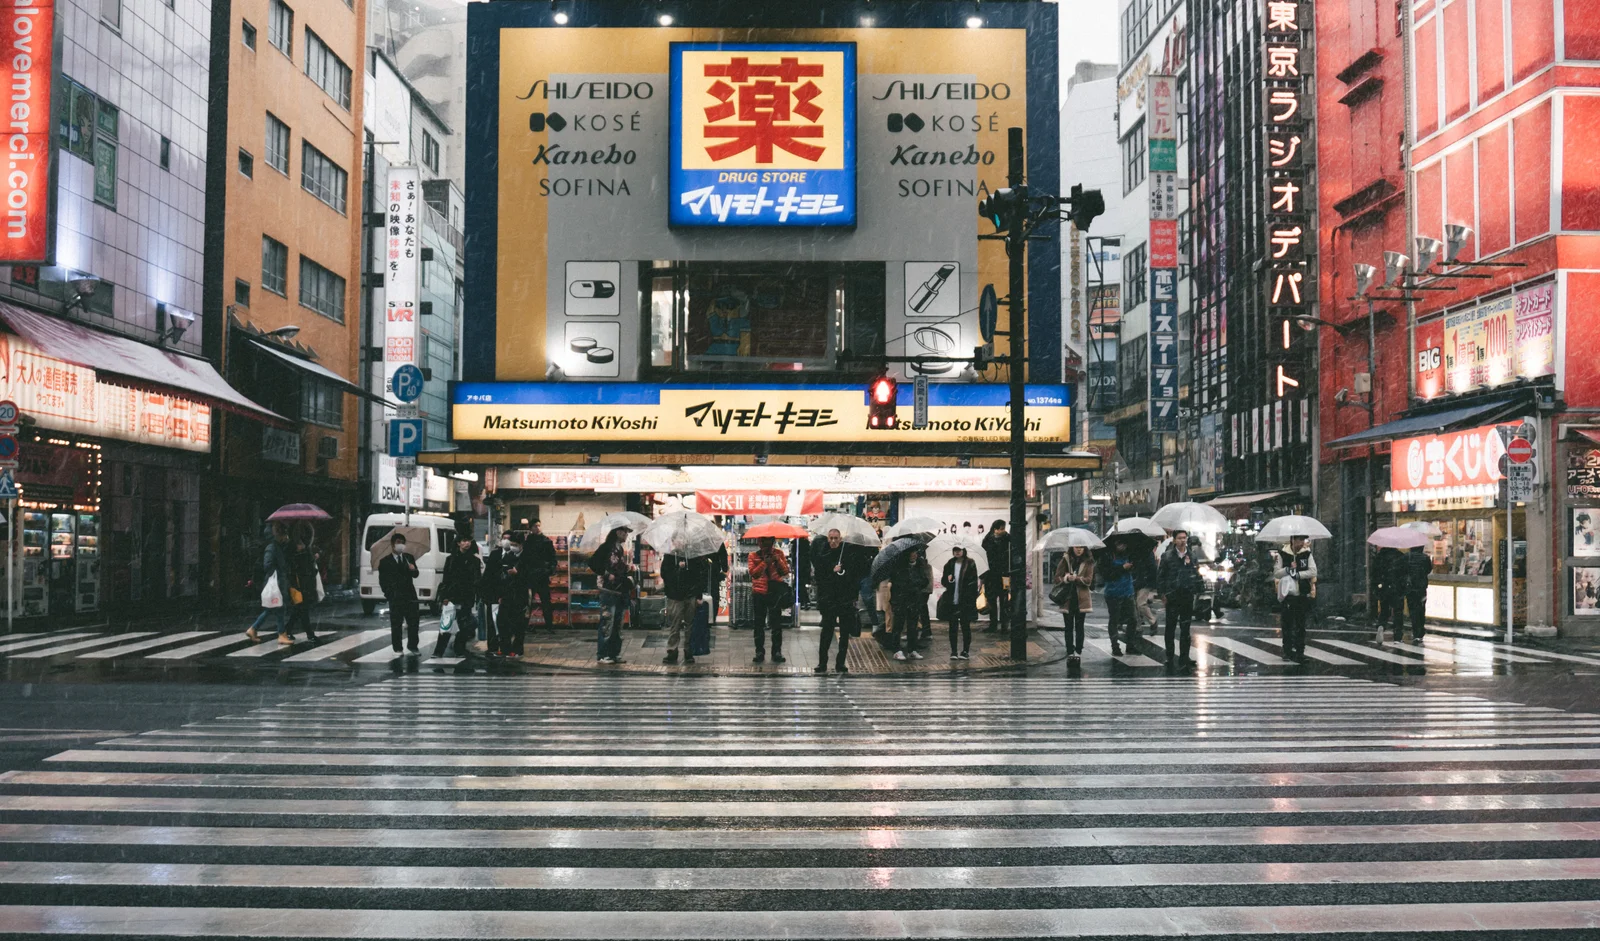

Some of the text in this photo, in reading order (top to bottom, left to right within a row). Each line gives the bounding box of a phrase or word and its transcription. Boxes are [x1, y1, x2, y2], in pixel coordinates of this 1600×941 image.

[516, 80, 653, 100] SHISEIDO
[872, 80, 1011, 100] SHISEIDO
[703, 57, 826, 163] 薬
[574, 111, 641, 131] KOSÉ
[932, 112, 999, 132] KOSÉ
[532, 143, 637, 165] Kanebo
[890, 144, 995, 166] Kanebo
[540, 178, 631, 197] SOFINA
[718, 172, 807, 183] DRUG STORE
[898, 179, 990, 197] SOFINA
[1267, 0, 1302, 397] 東京ラジオデパート
[387, 338, 412, 347] SOD
[1418, 346, 1441, 372] BIG
[16, 360, 78, 396] 大人の通信販売
[399, 373, 411, 397] P
[0, 407, 14, 418] 20
[483, 415, 658, 430] Matsumoto KiYoshi
[974, 417, 1042, 431] KiYohi
[399, 422, 417, 453] P
[1425, 433, 1481, 485] 宝くじ
